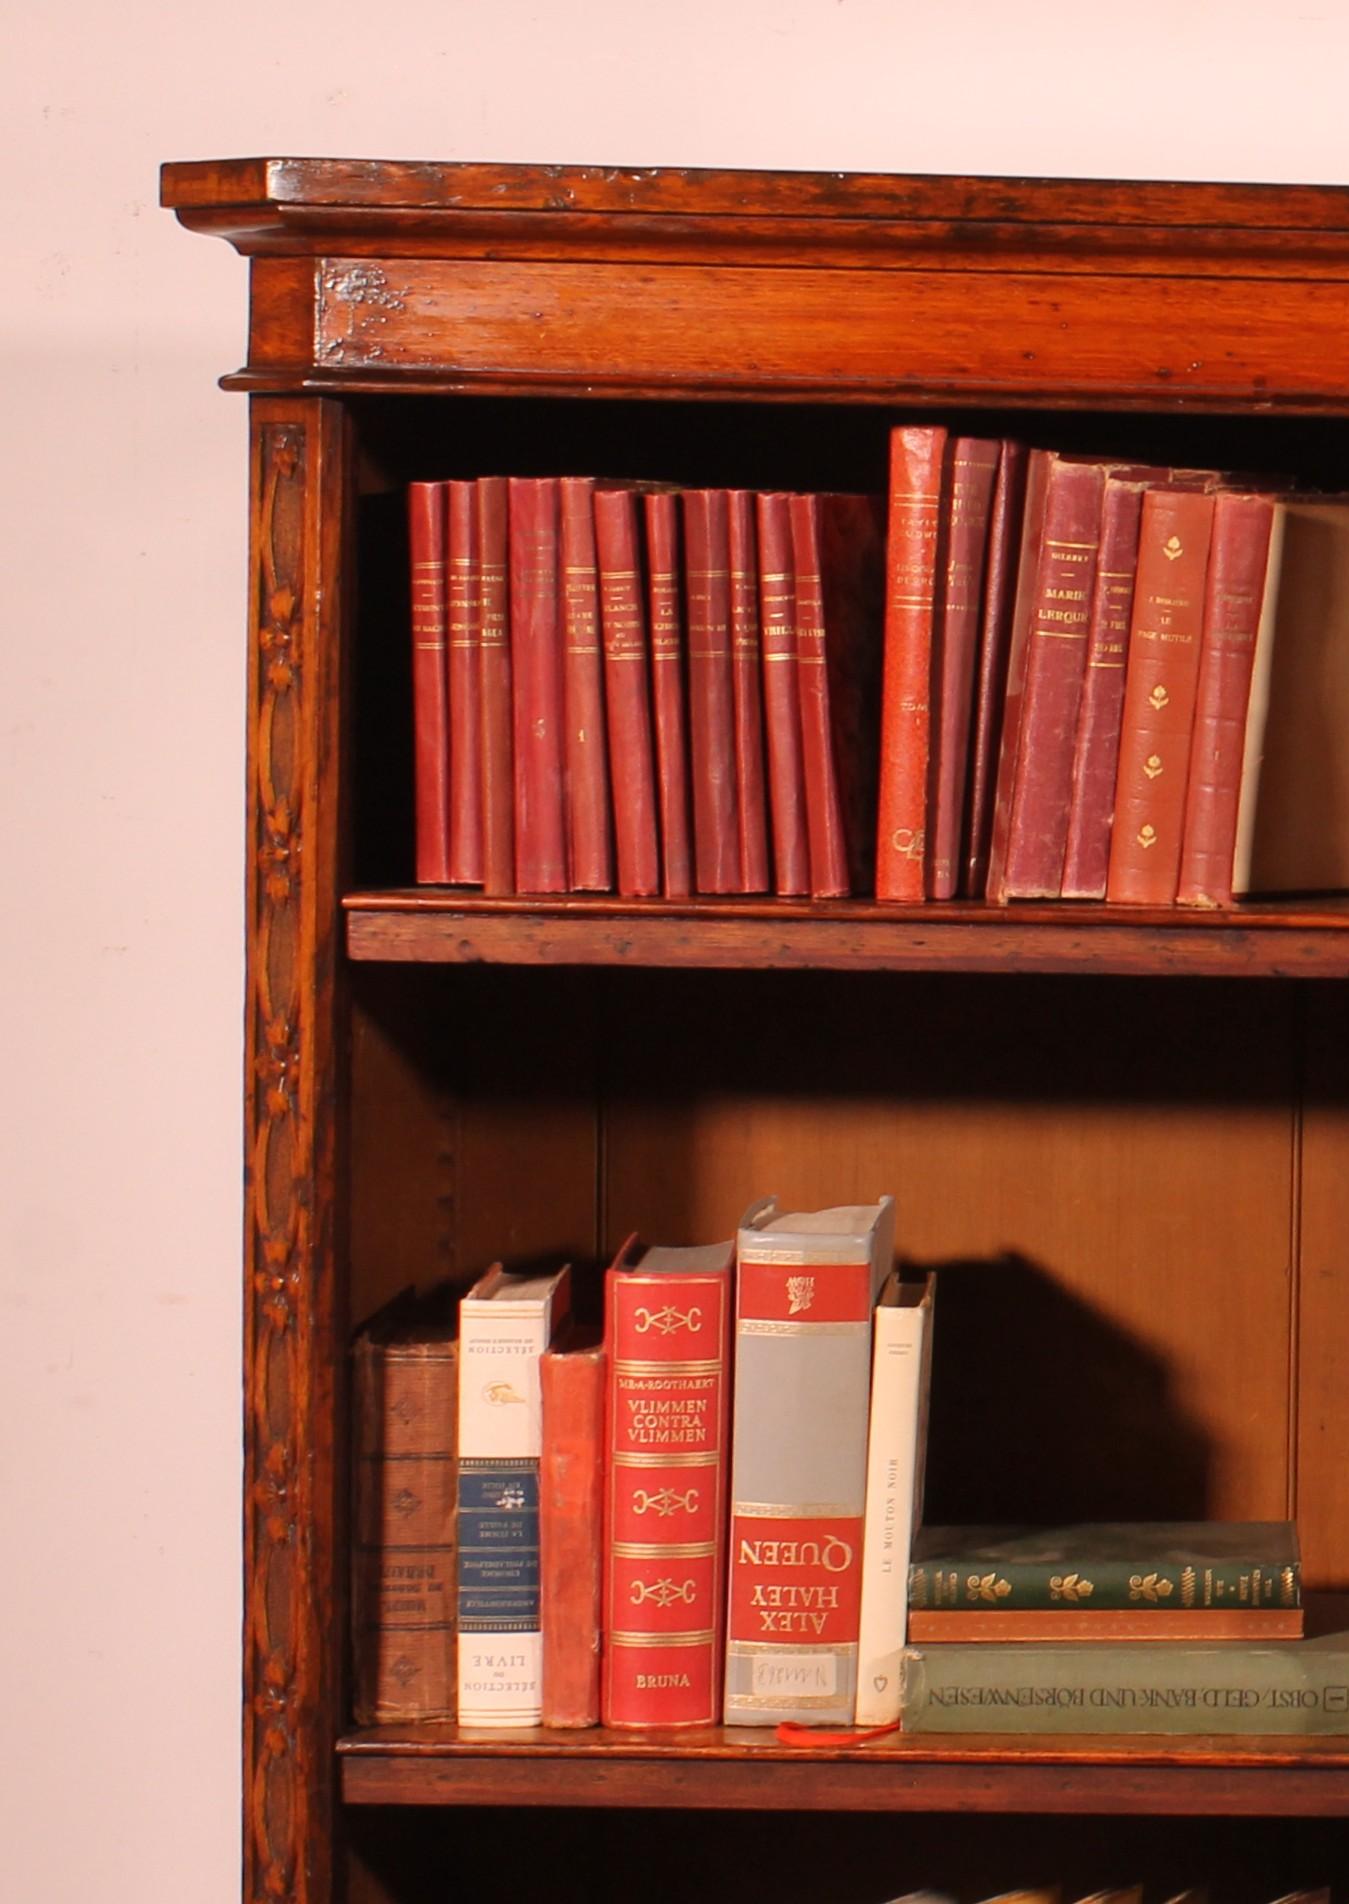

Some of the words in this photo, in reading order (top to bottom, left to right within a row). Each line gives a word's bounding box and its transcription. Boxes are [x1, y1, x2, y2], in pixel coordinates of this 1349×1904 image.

[627, 1399, 707, 1414] VLIMMEN
[633, 1414, 702, 1429] CONTRA
[627, 1428, 707, 1443] VLIMMEN
[738, 1534, 853, 1572] QUEEN
[749, 1585, 839, 1608] HALEY
[759, 1610, 829, 1635] ALEX
[472, 1655, 525, 1667] LIVRE
[464, 1681, 536, 1692] SÉLECTION
[636, 1673, 691, 1689] BRUNA
[928, 1686, 1085, 1709] BÖRSENWESEN
[1089, 1687, 1137, 1708] UND
